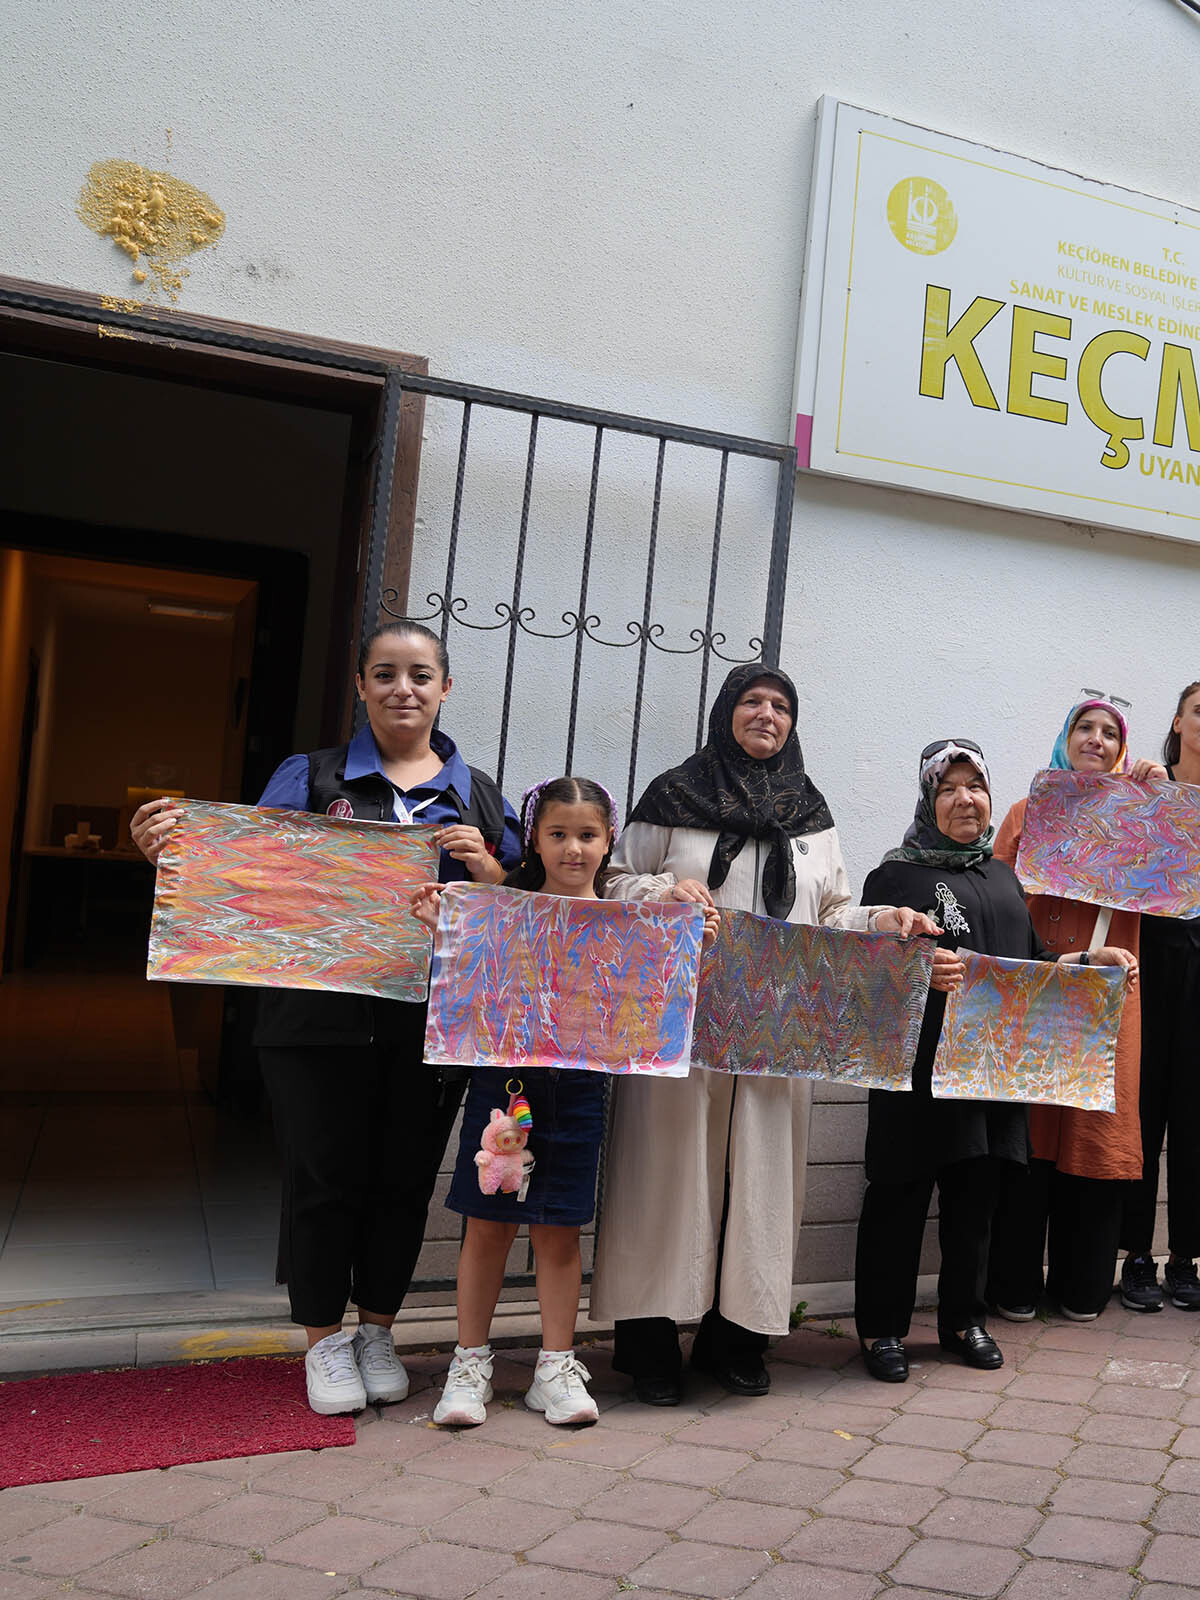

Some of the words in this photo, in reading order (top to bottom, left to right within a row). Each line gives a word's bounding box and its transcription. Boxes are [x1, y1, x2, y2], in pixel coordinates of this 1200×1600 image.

[1057, 240, 1130, 273] KEÇİÖREN
[1133, 261, 1198, 291] BELEDİYE
[1162, 248, 1185, 265] T.C.
[1009, 279, 1065, 304] SANAT
[1069, 293, 1089, 312] VE
[1092, 299, 1154, 328] MESLEK
[1107, 279, 1122, 293] VE
[1125, 282, 1168, 305] SOSYAL
